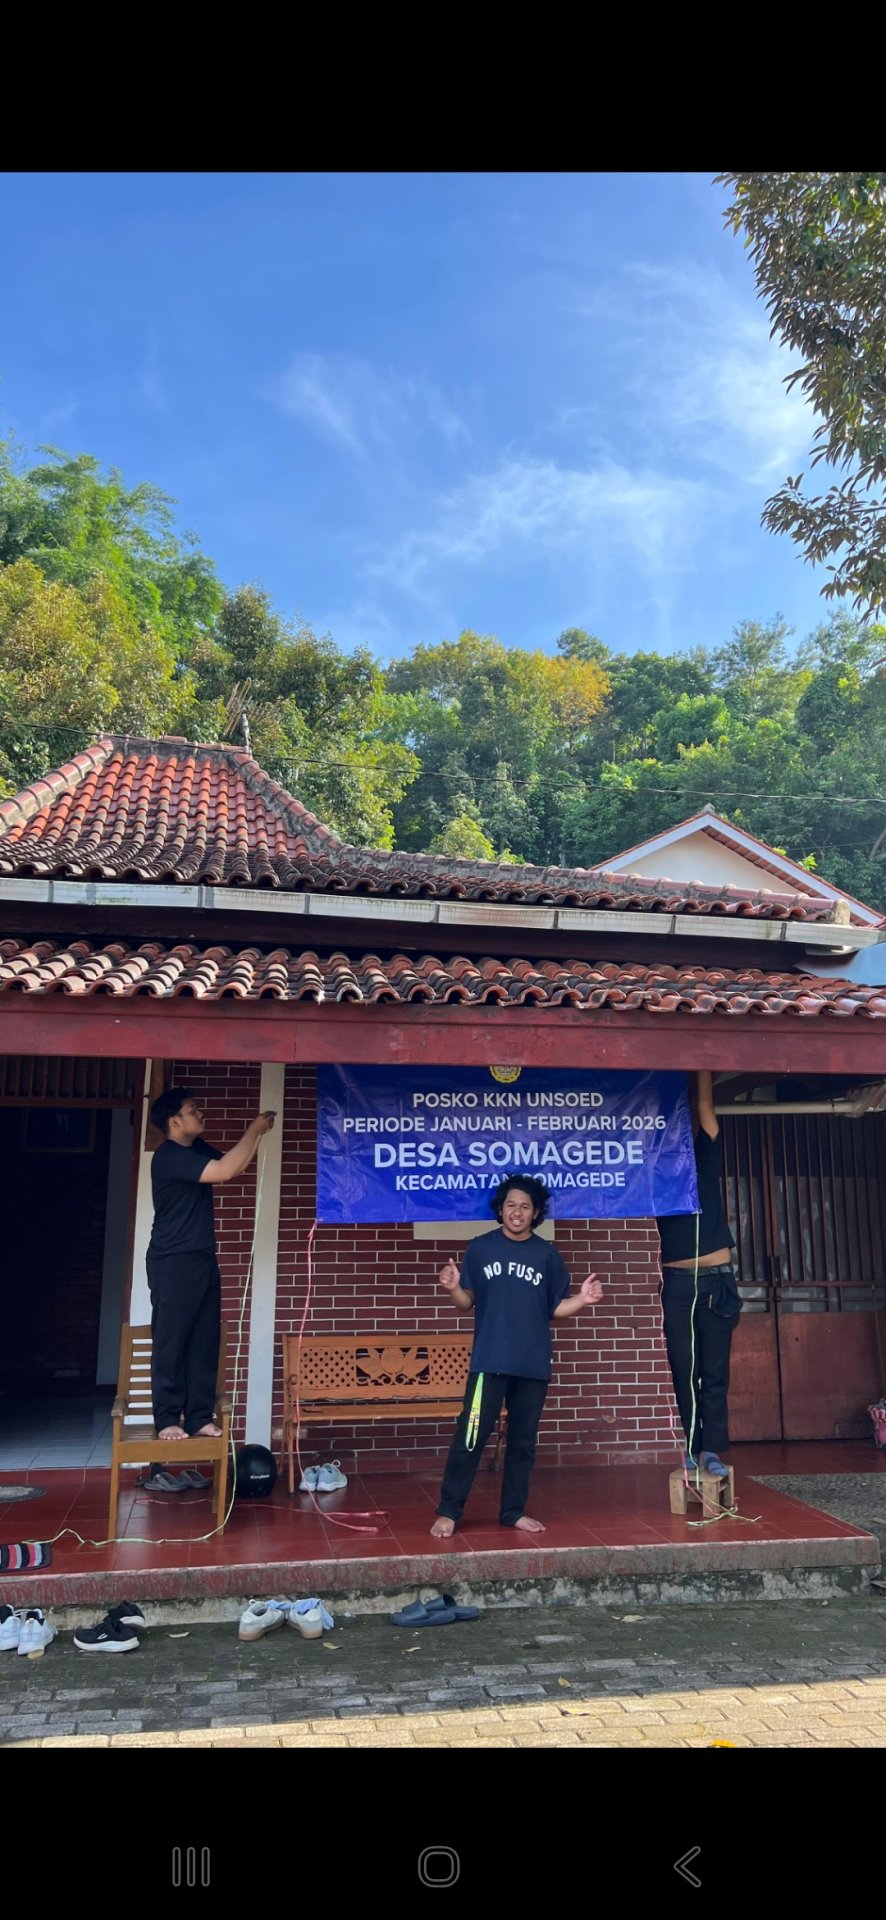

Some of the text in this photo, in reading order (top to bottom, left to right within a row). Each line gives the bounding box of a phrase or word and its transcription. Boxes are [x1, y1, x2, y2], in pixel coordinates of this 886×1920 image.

[413, 1092, 604, 1108] POSKO KKN UNSOED
[343, 1117, 425, 1133] PERIODE
[430, 1116, 512, 1132] JANUARI
[527, 1115, 617, 1131] FEBRUARI
[621, 1115, 667, 1130] 2026
[374, 1140, 644, 1168] DESA SOMAGEDE
[522, 1172, 626, 1189] OMAGEDE
[483, 1261, 543, 1286] NO FUSS
